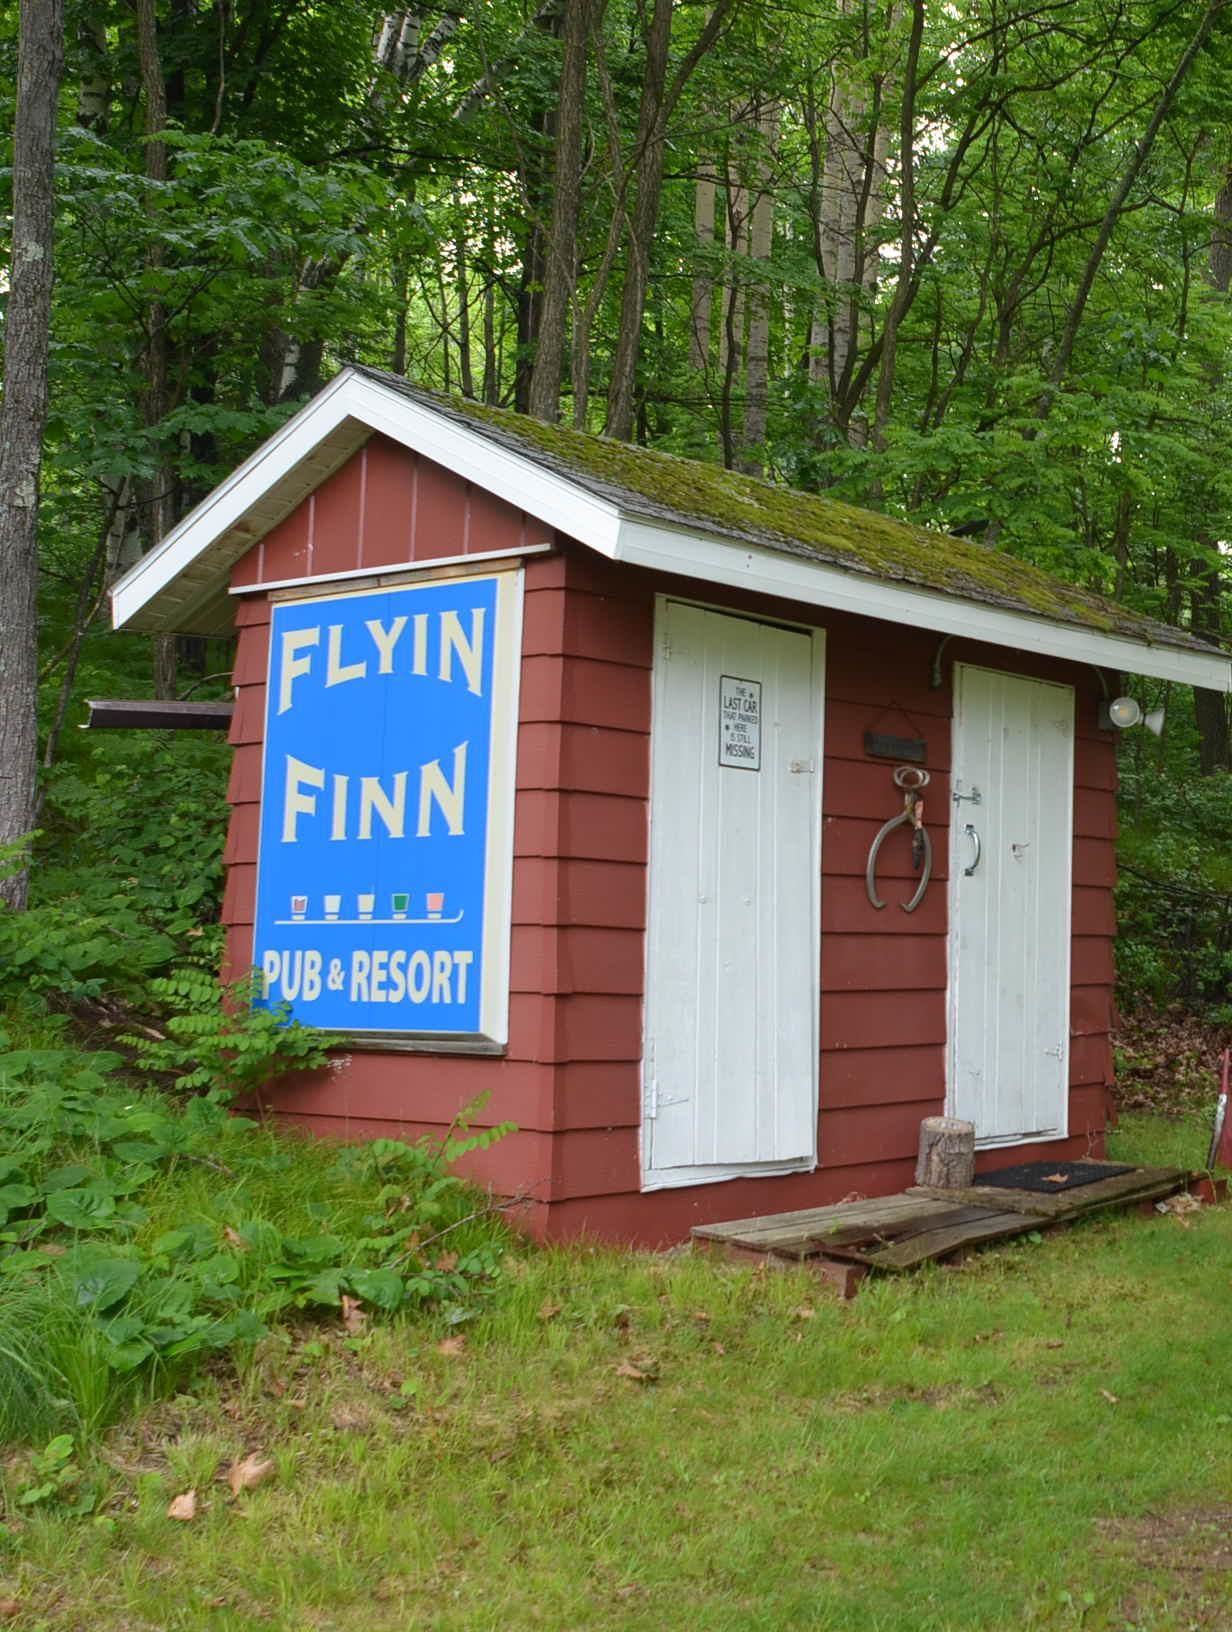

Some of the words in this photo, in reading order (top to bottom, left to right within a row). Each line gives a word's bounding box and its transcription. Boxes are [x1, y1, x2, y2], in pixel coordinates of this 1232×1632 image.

[277, 607, 487, 716] FLYIN
[735, 687, 747, 697] THE
[723, 696, 741, 711] LAST
[744, 699, 757, 713] CAR
[734, 723, 747, 733] HERE
[725, 743, 755, 760] MISSING
[281, 740, 469, 843] FINN
[262, 950, 322, 1001] PUB
[327, 958, 345, 991] &
[351, 950, 474, 1004] RESORT
